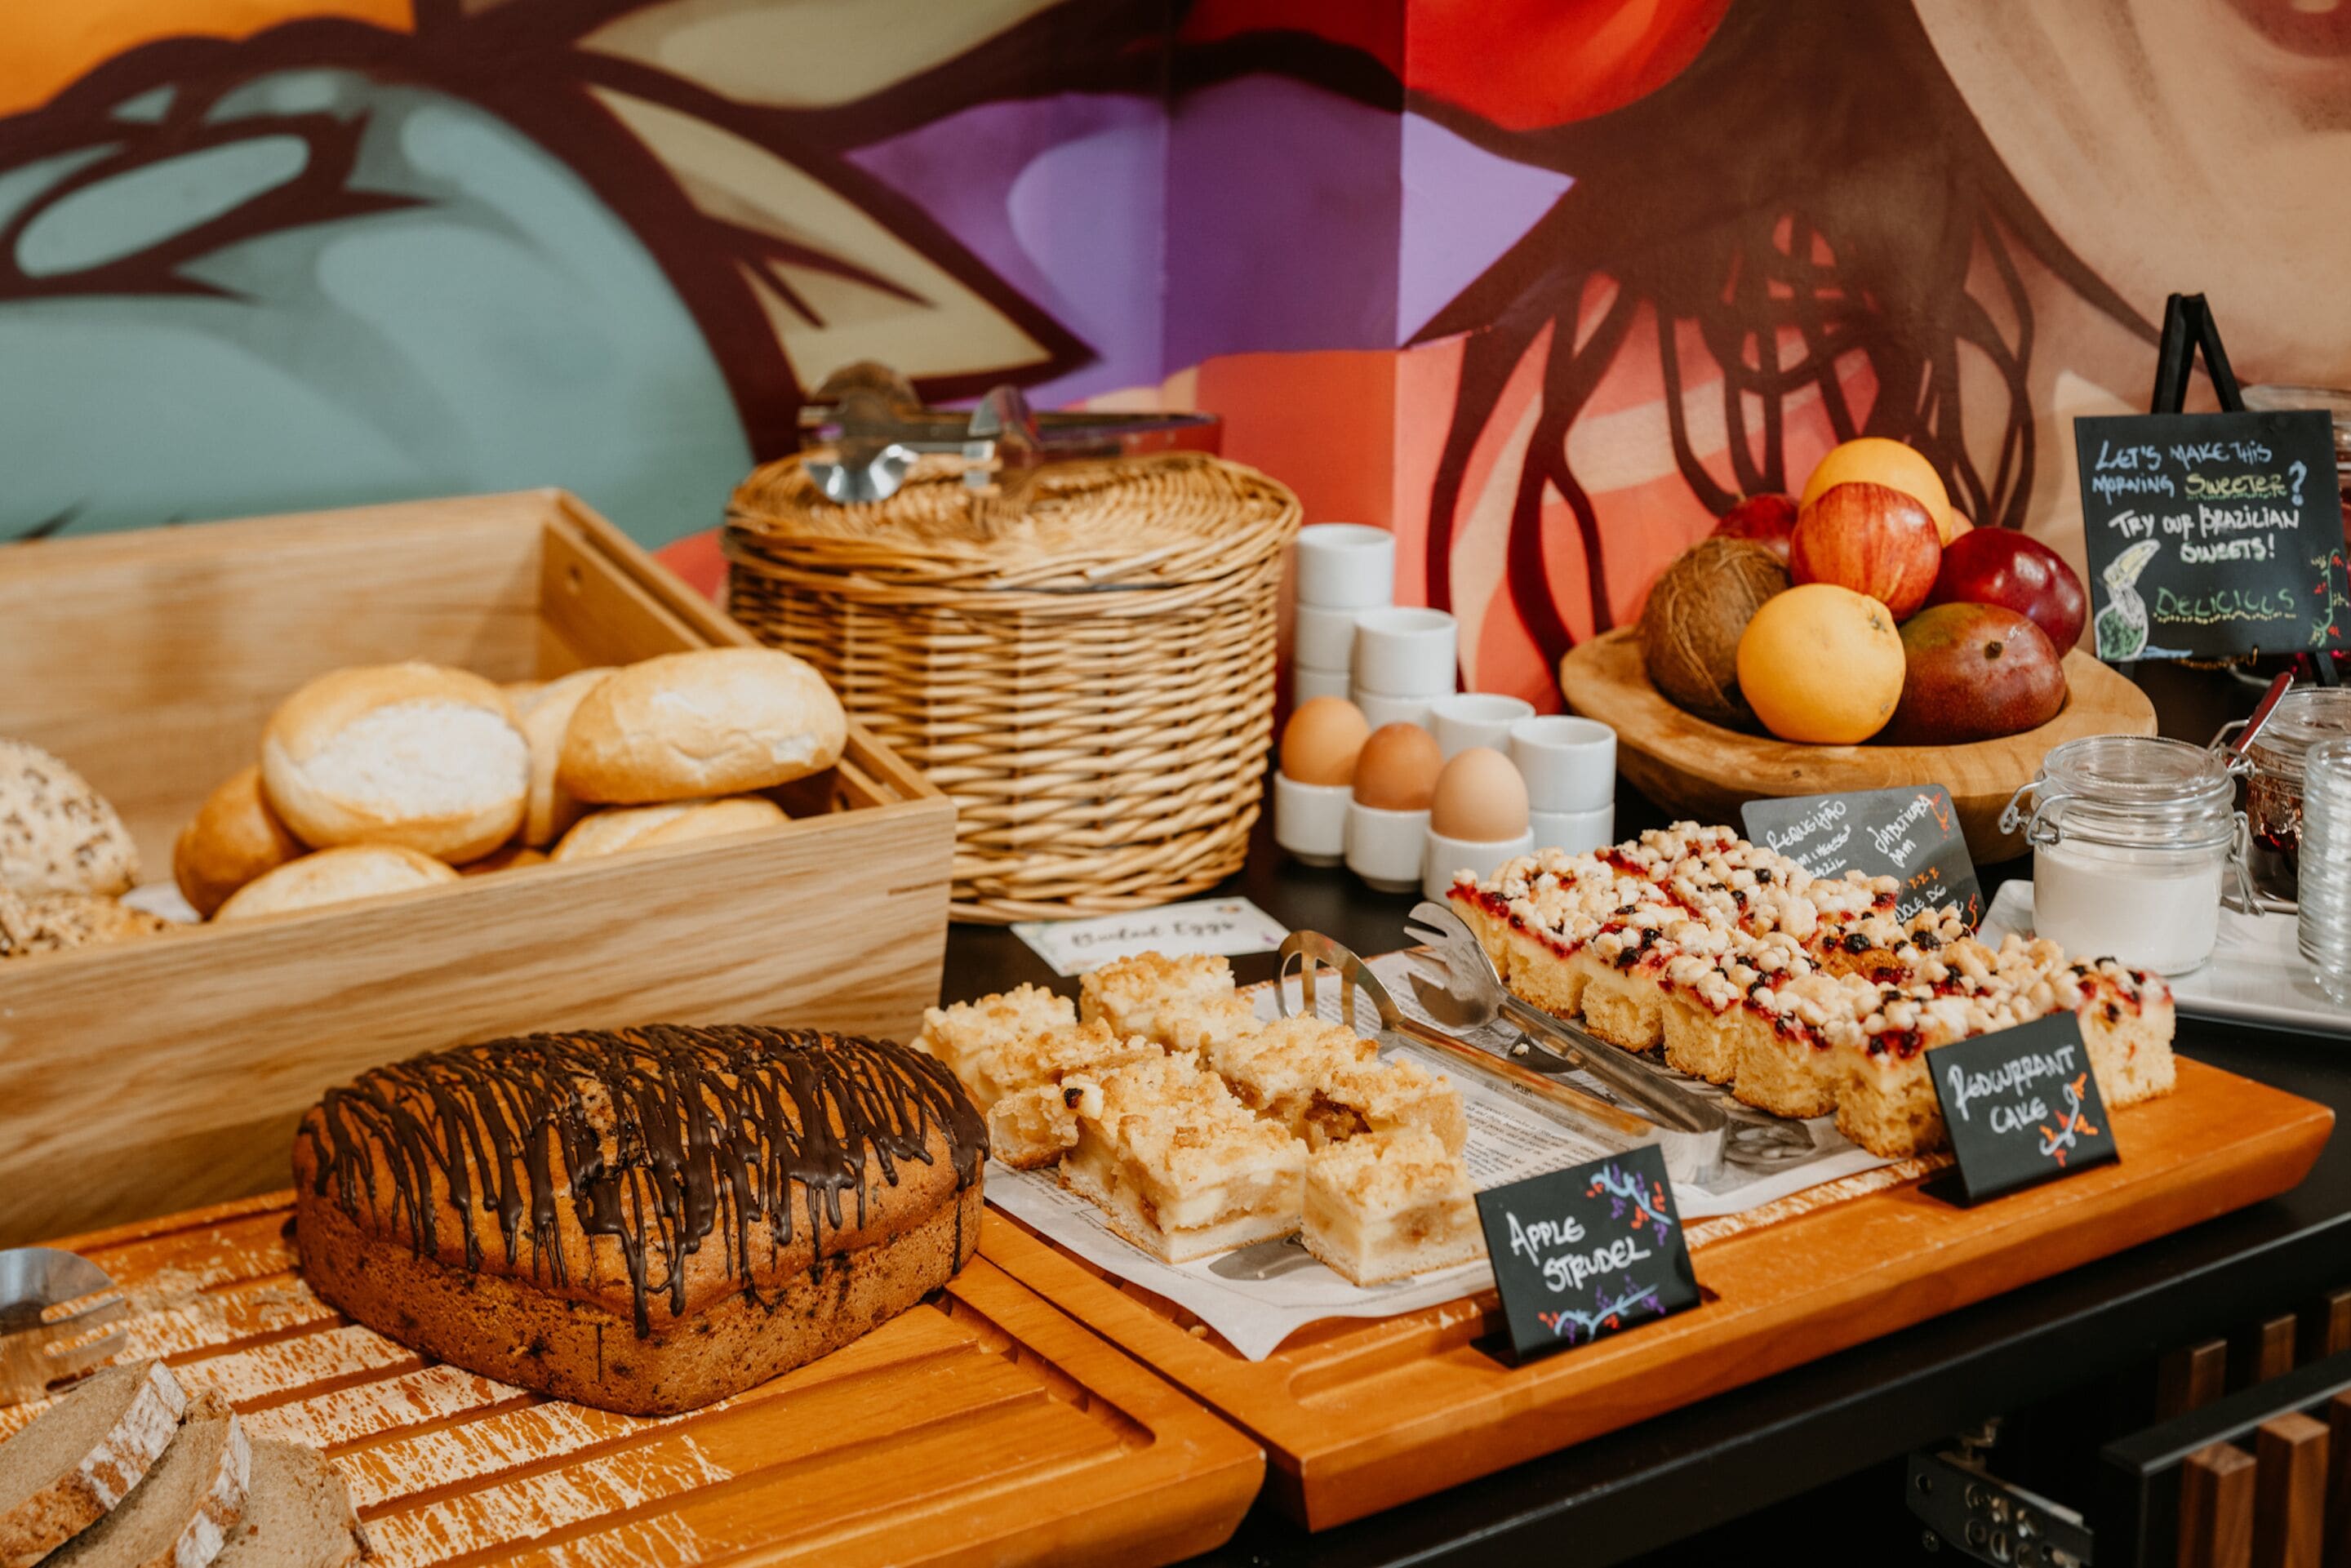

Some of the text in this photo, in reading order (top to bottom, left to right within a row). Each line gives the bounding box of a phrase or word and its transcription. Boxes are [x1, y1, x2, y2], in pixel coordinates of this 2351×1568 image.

[2095, 441, 2272, 471] LET'S MAKE THIS
[2091, 473, 2175, 505] MORNING
[2109, 504, 2300, 540] TRY OUR BRAZILIAN
[1989, 1096, 2048, 1134] CAKE
[1505, 1211, 1585, 1266] APPLE
[1543, 1236, 1651, 1292] STRUDEL
